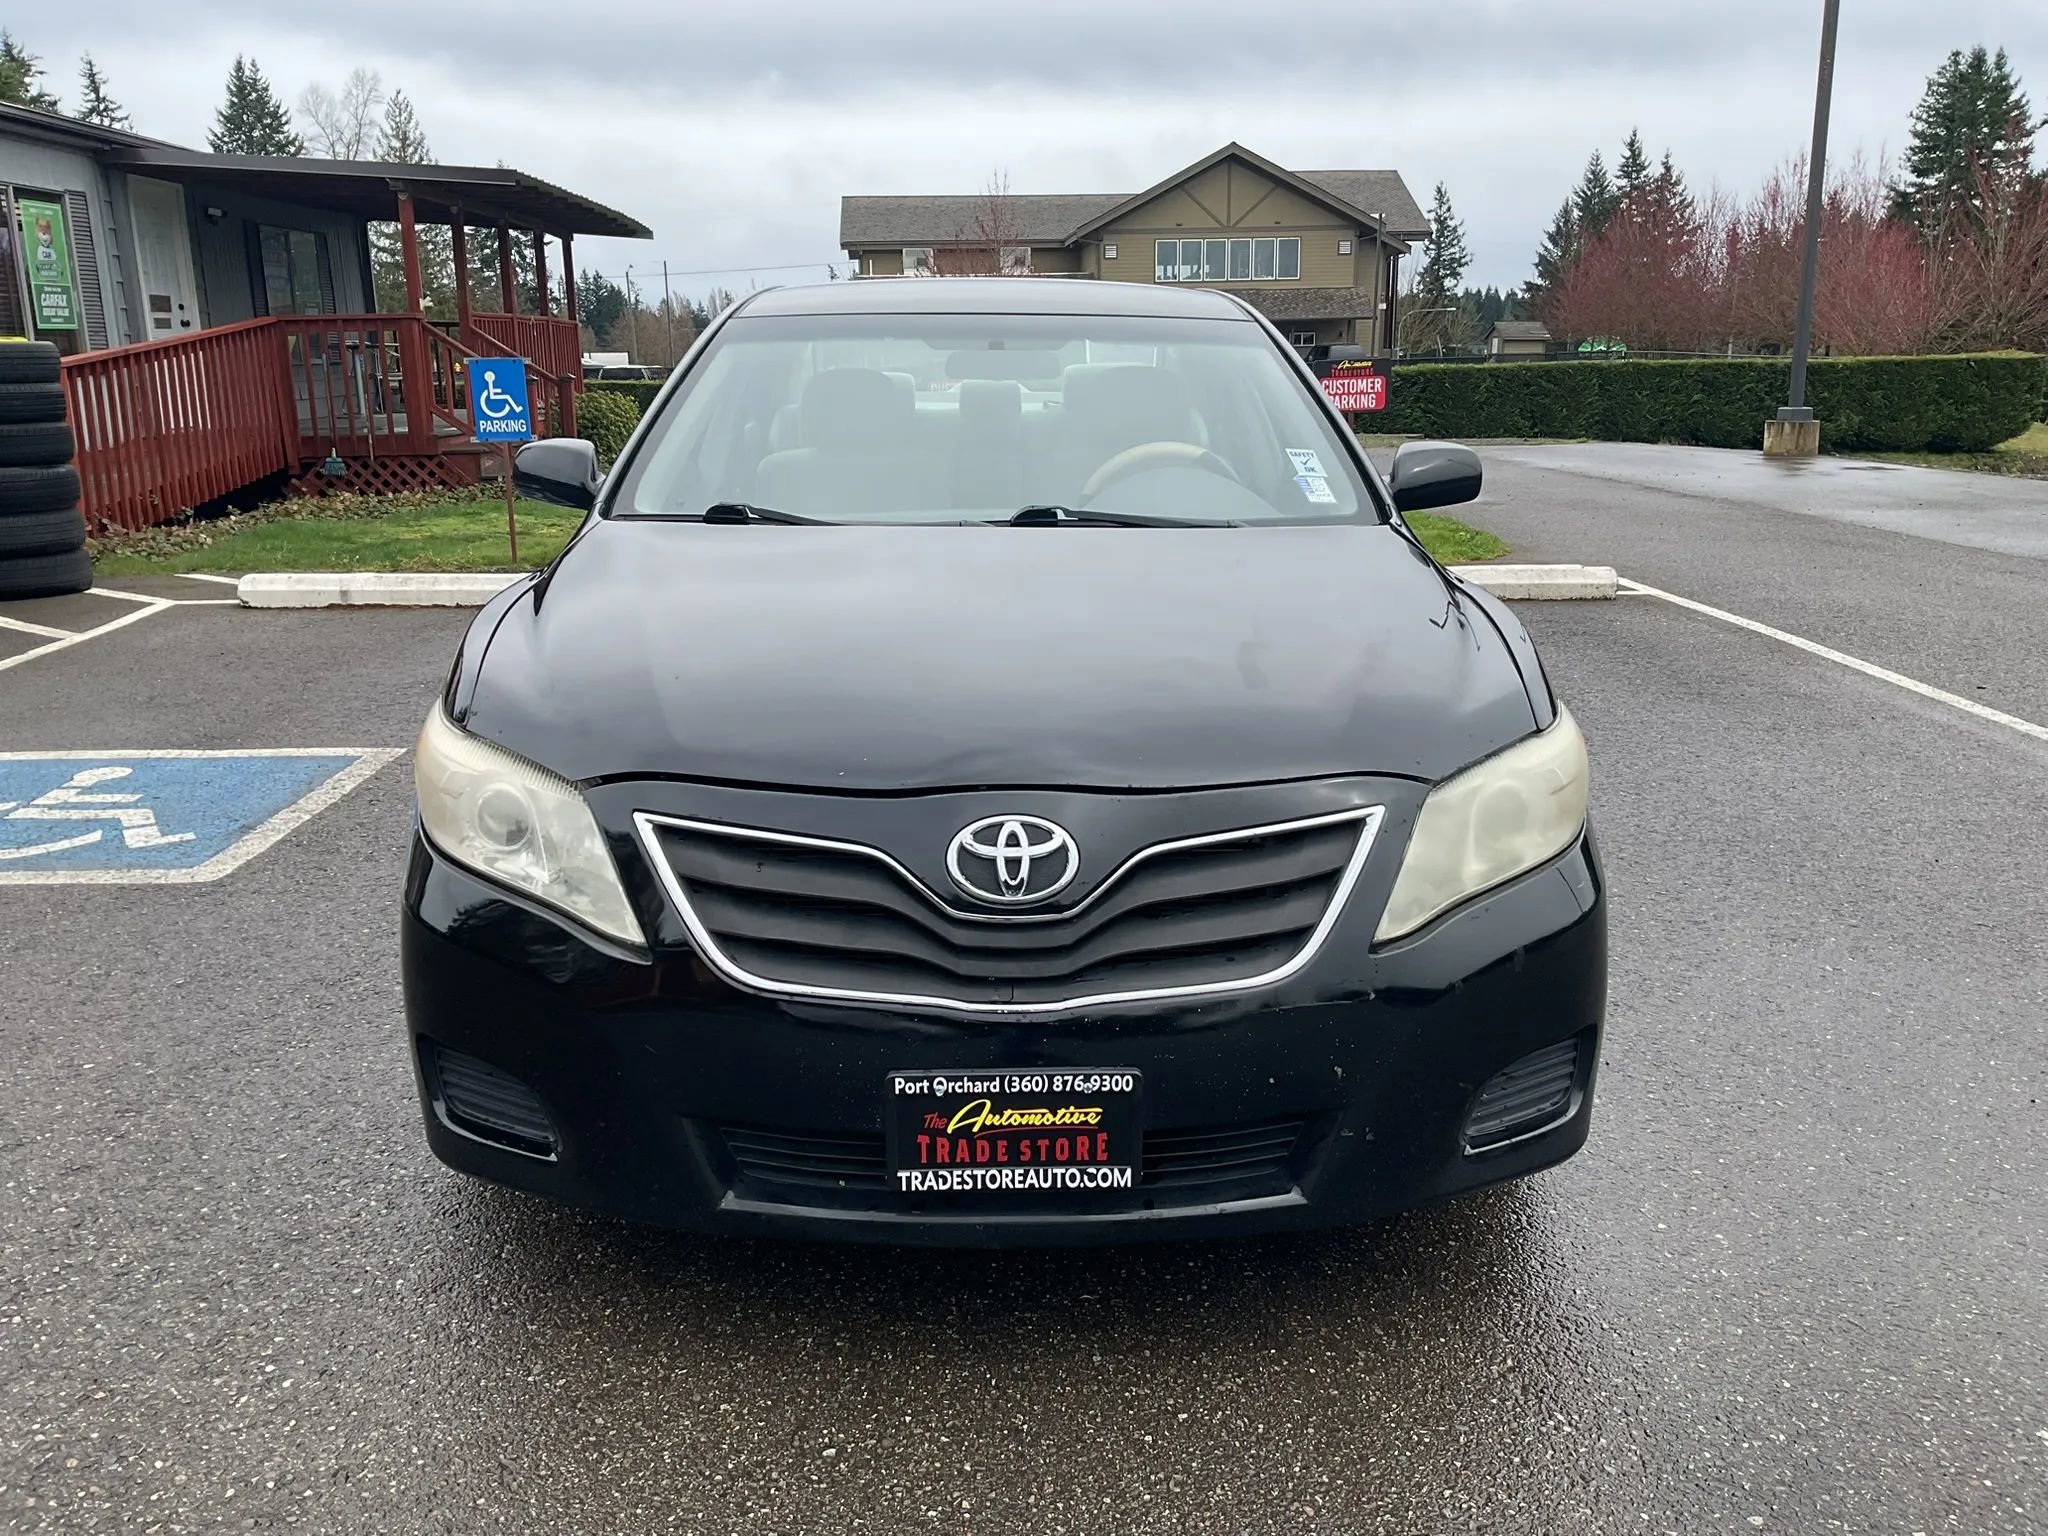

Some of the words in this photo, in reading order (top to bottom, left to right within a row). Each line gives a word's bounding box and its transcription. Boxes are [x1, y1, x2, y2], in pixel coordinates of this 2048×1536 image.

[41, 293, 68, 307] CARFAX
[1322, 378, 1382, 394] CUSTOMER
[480, 419, 527, 433] PARKING
[894, 1077, 929, 1094] Port
[933, 1076, 1000, 1096] Orchard
[1004, 1075, 1048, 1093] (360)
[923, 1111, 947, 1129] The
[946, 1098, 1103, 1134] Automotive
[917, 1134, 1008, 1164] TRADE
[1019, 1131, 1108, 1161] STORE
[897, 1167, 1132, 1191] TRADESTOREAUTO.COM
